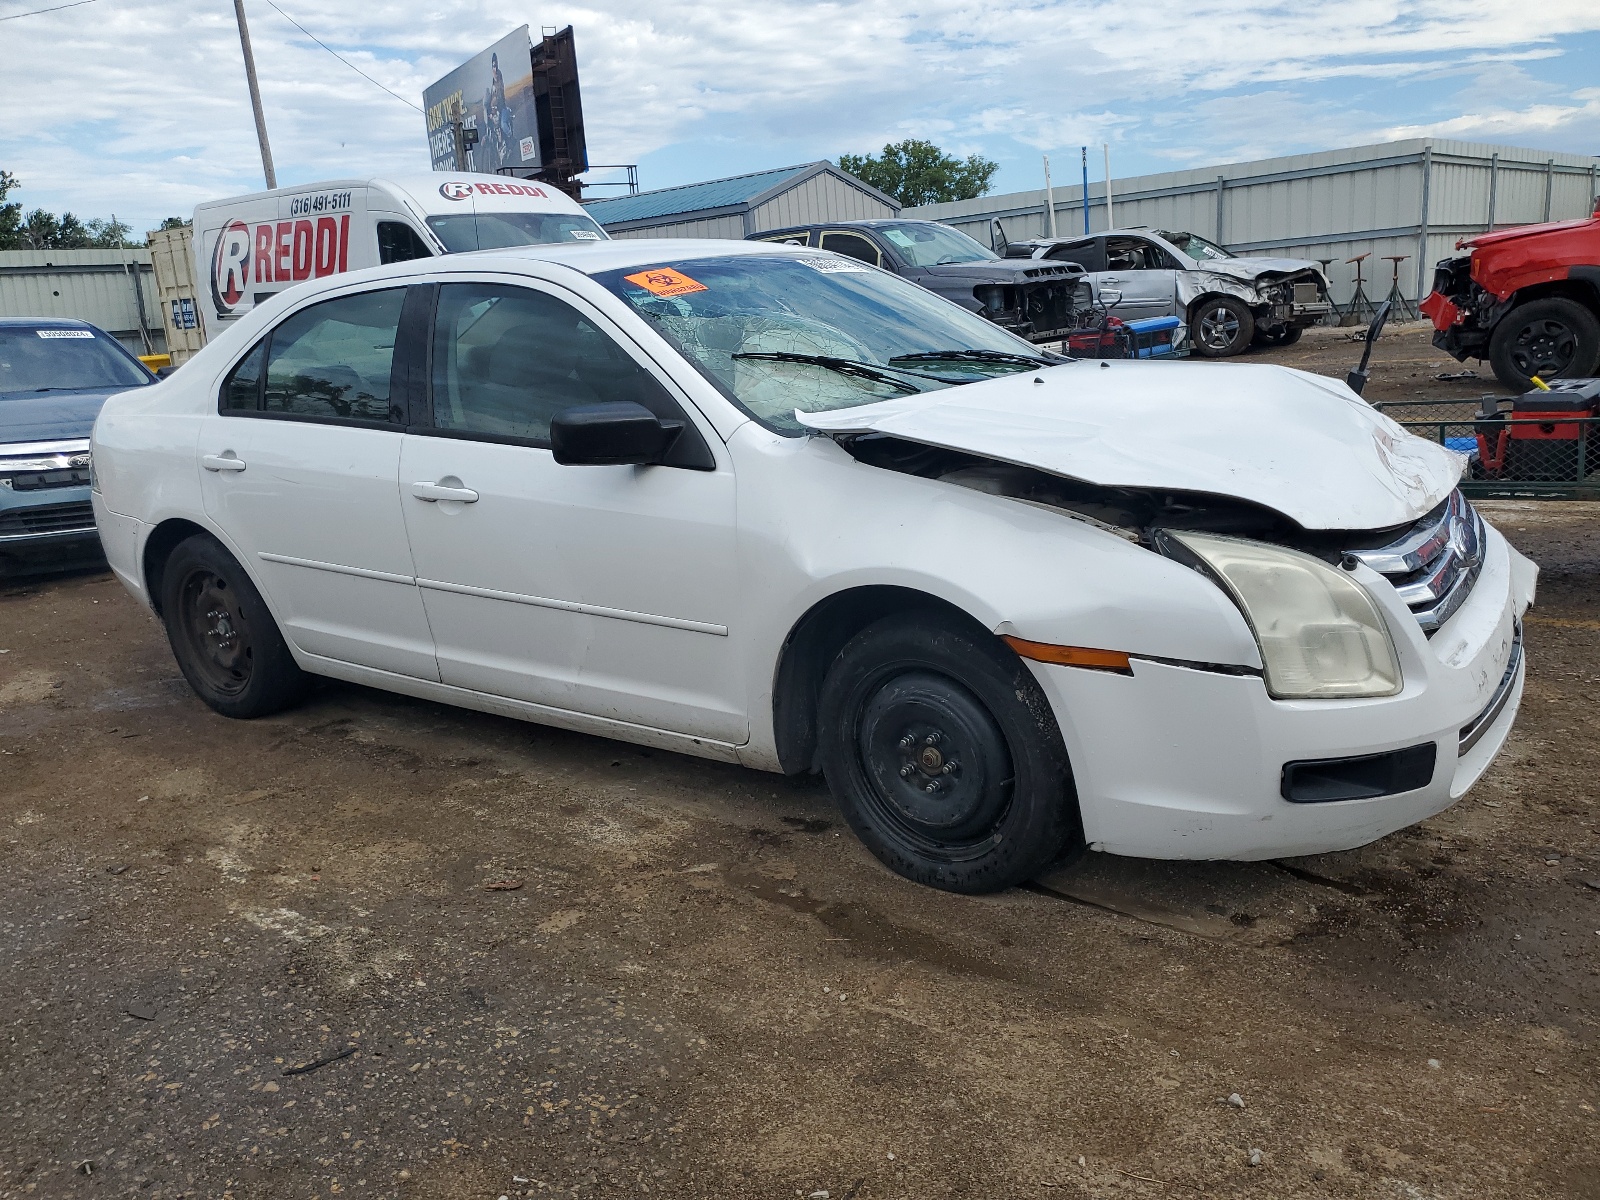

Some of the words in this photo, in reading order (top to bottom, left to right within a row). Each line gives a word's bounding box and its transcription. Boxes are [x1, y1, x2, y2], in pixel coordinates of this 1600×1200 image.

[427, 102, 444, 132] LOOK
[442, 90, 467, 123] TWE.
[462, 114, 478, 129] IFE
[474, 183, 548, 198] REDDI
[291, 195, 312, 217] (316)
[313, 192, 352, 212] 491-5111
[255, 215, 350, 283] REDDI
